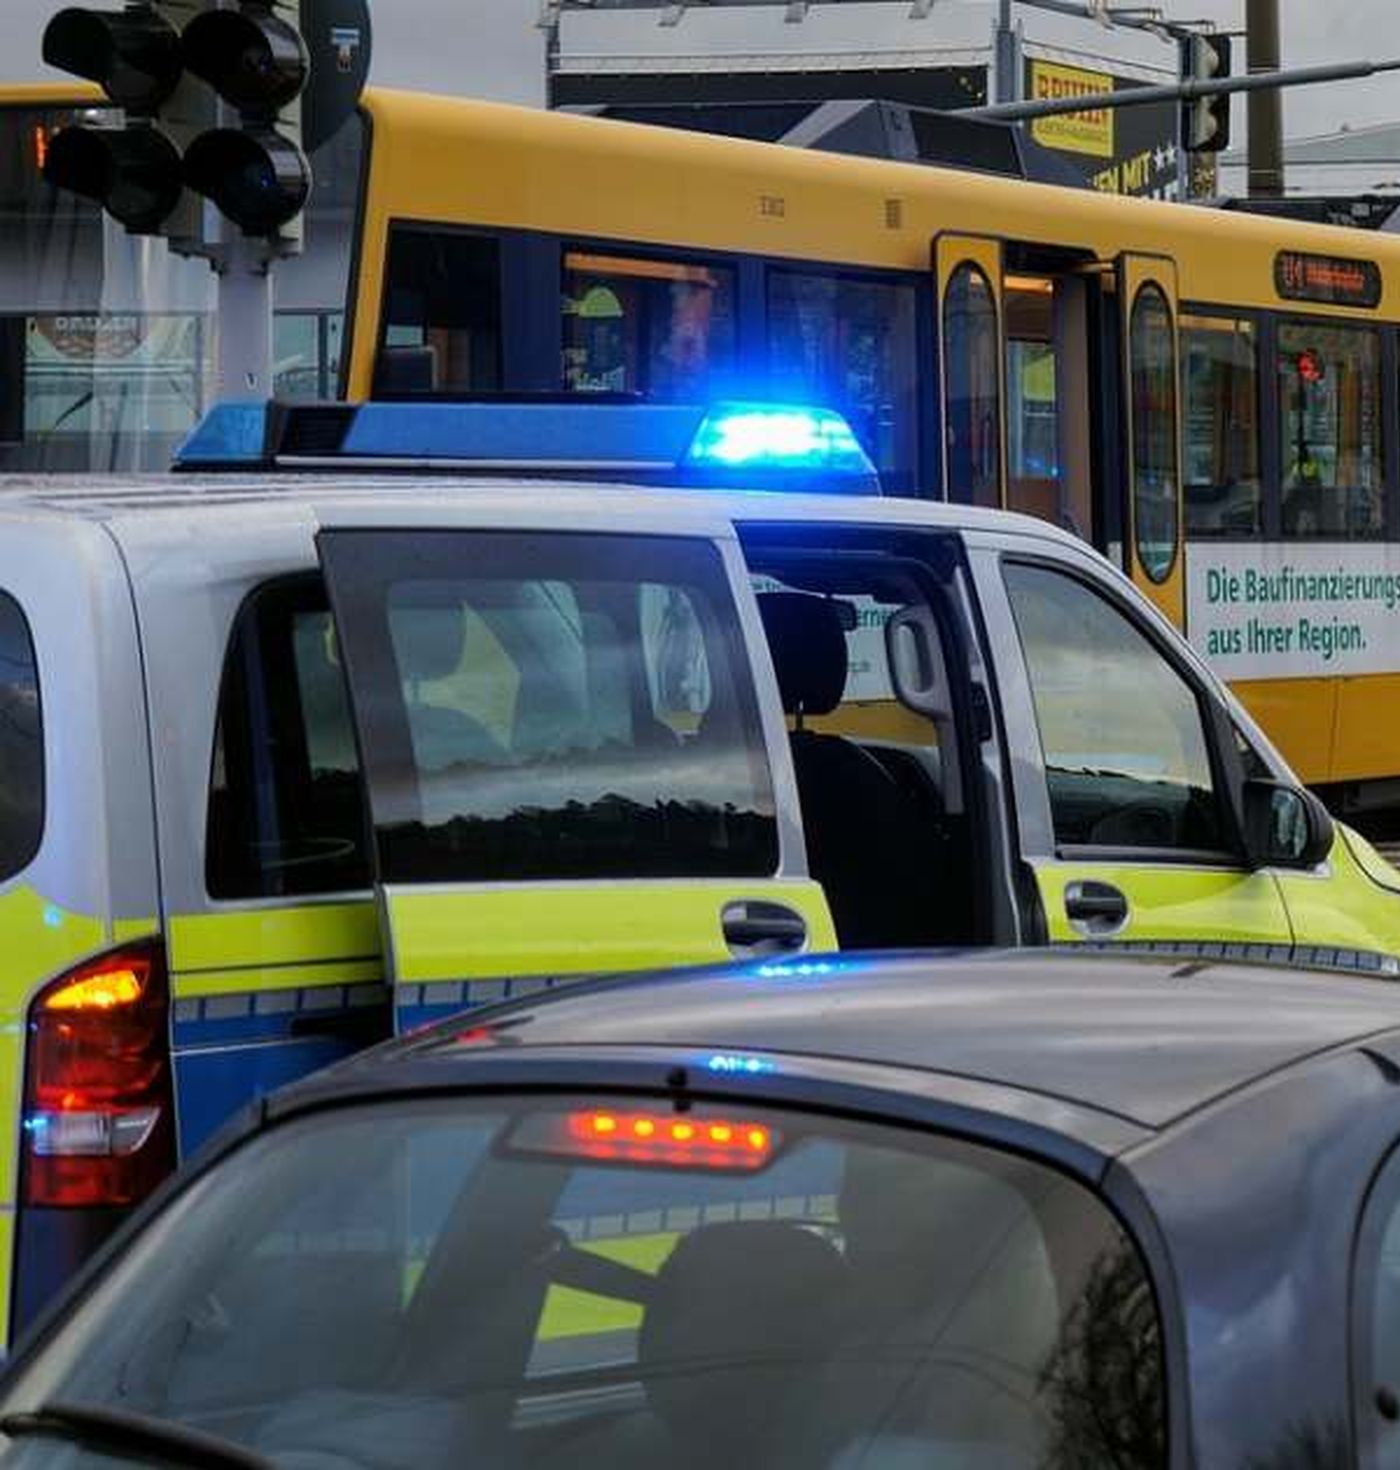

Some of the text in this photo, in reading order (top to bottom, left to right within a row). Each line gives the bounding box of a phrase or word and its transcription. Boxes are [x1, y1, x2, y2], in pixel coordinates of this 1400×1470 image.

[1207, 567, 1240, 602] Die
[1208, 616, 1366, 660] aus Ihrer Region.
